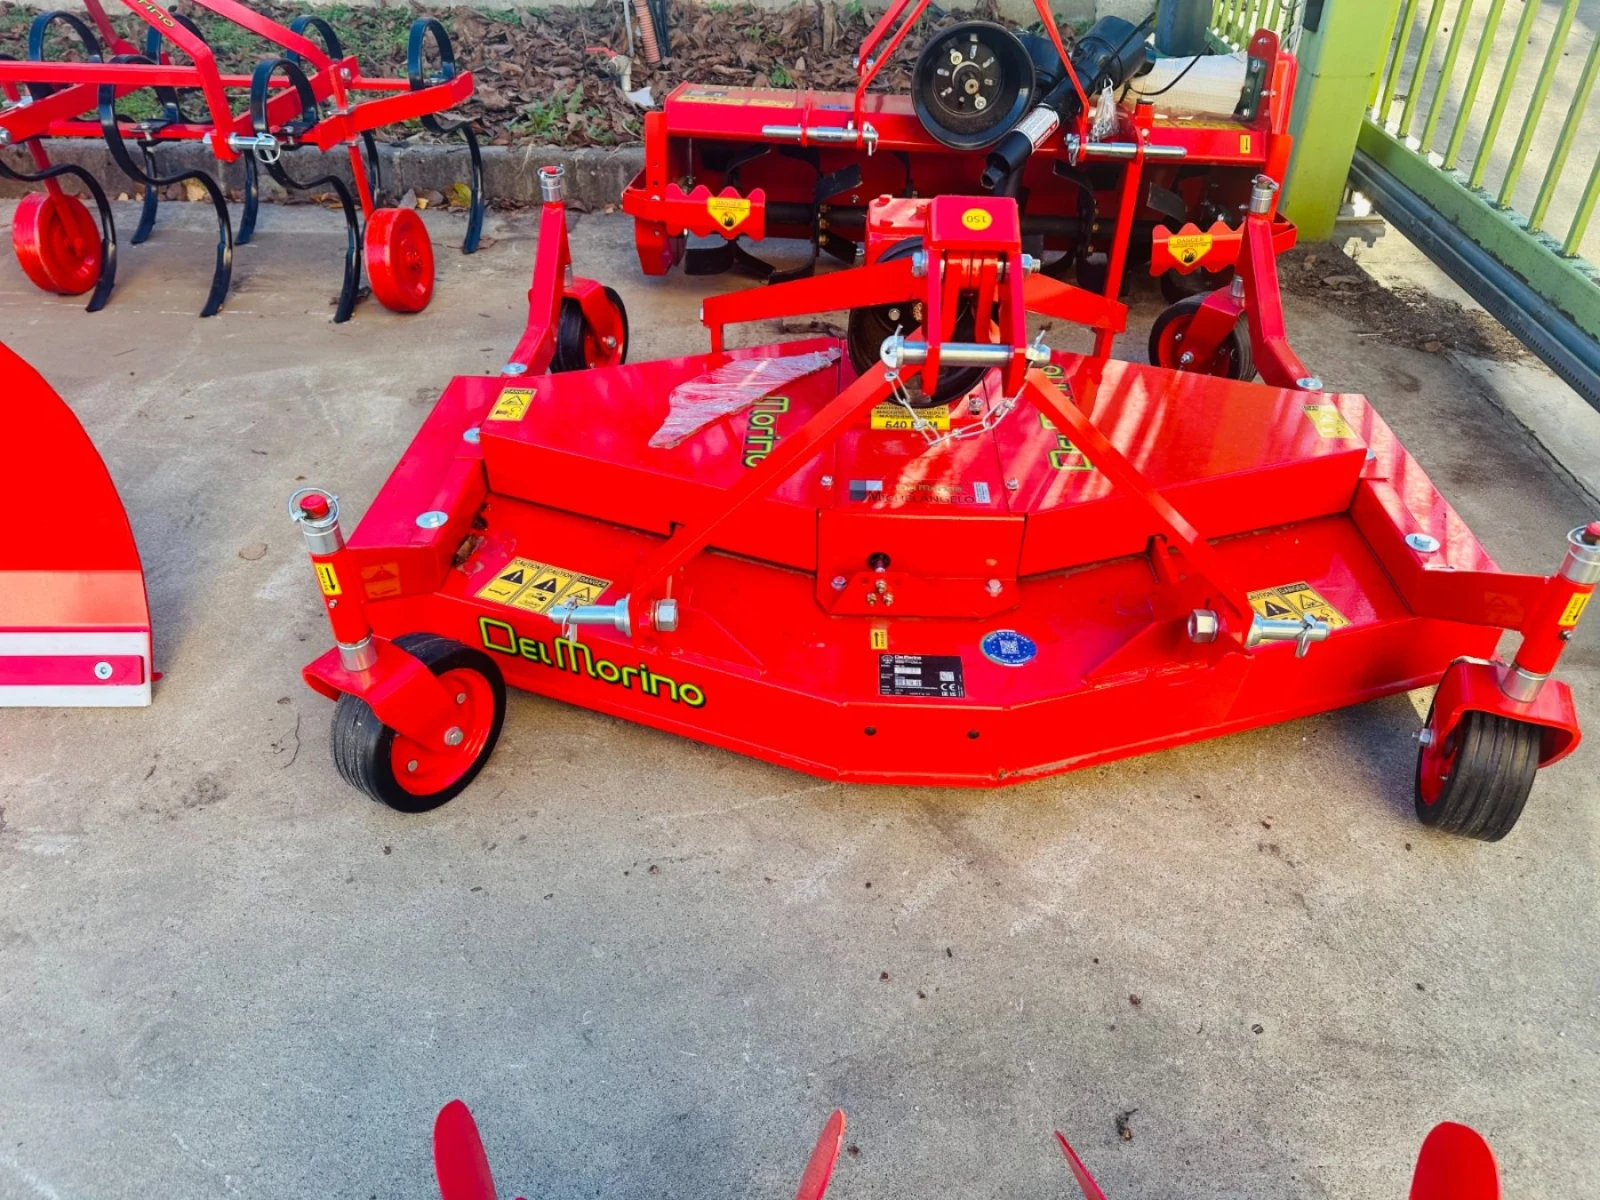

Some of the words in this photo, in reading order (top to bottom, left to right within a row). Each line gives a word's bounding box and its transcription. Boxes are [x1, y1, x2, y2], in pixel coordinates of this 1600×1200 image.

[885, 420, 908, 430] 540
[867, 490, 975, 504] MICHELANGELO
[514, 559, 541, 571] CAUTION
[546, 567, 574, 580] CAUTION
[579, 575, 609, 588] DANGER
[1279, 584, 1307, 595] DANGER
